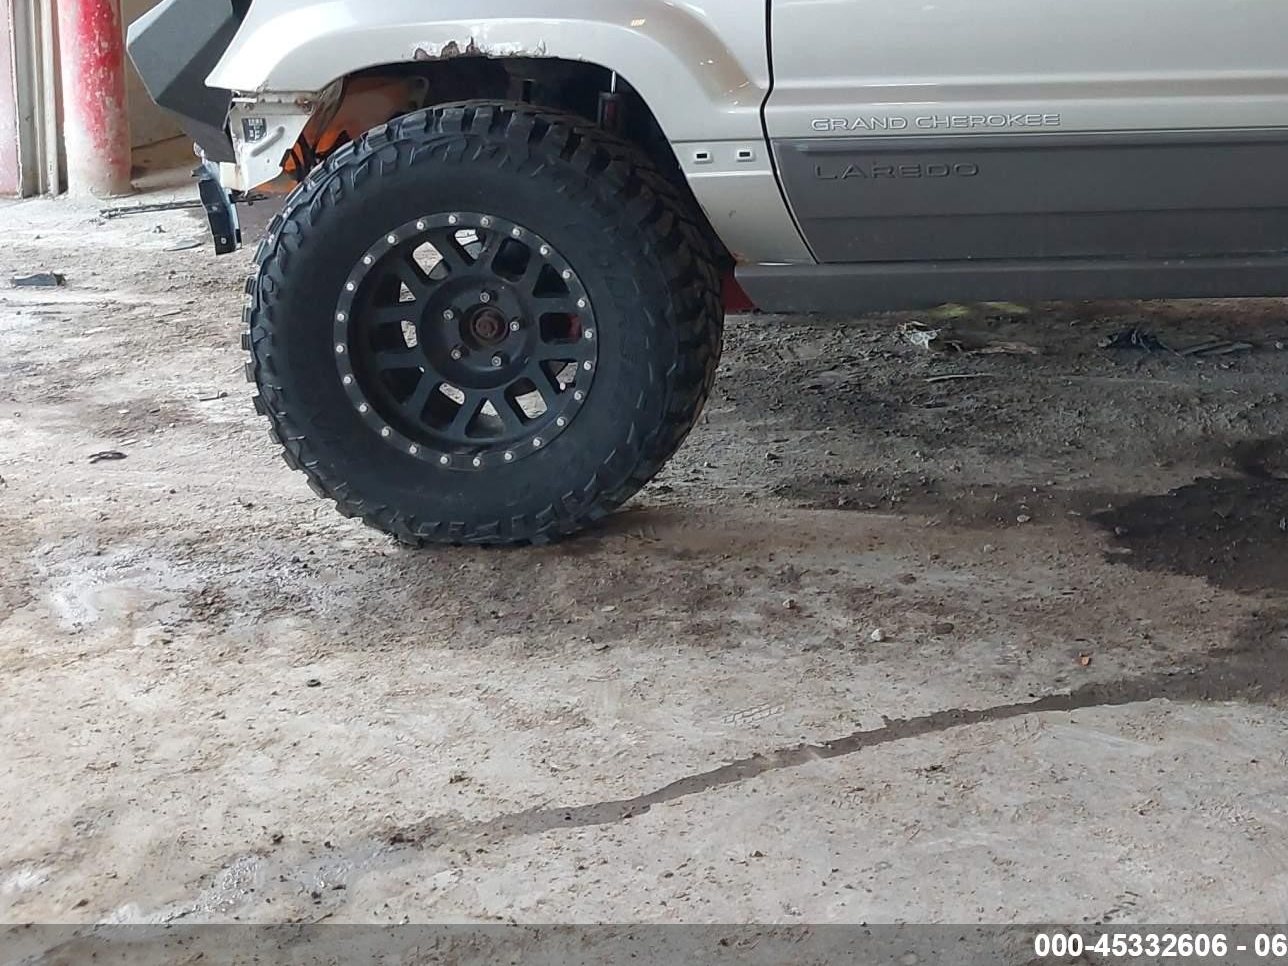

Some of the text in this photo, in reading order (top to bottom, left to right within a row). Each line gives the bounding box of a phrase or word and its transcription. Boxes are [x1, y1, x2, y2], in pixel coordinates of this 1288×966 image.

[811, 113, 1061, 132] GRAND CHEROKEE
[814, 162, 979, 180] LAREDO
